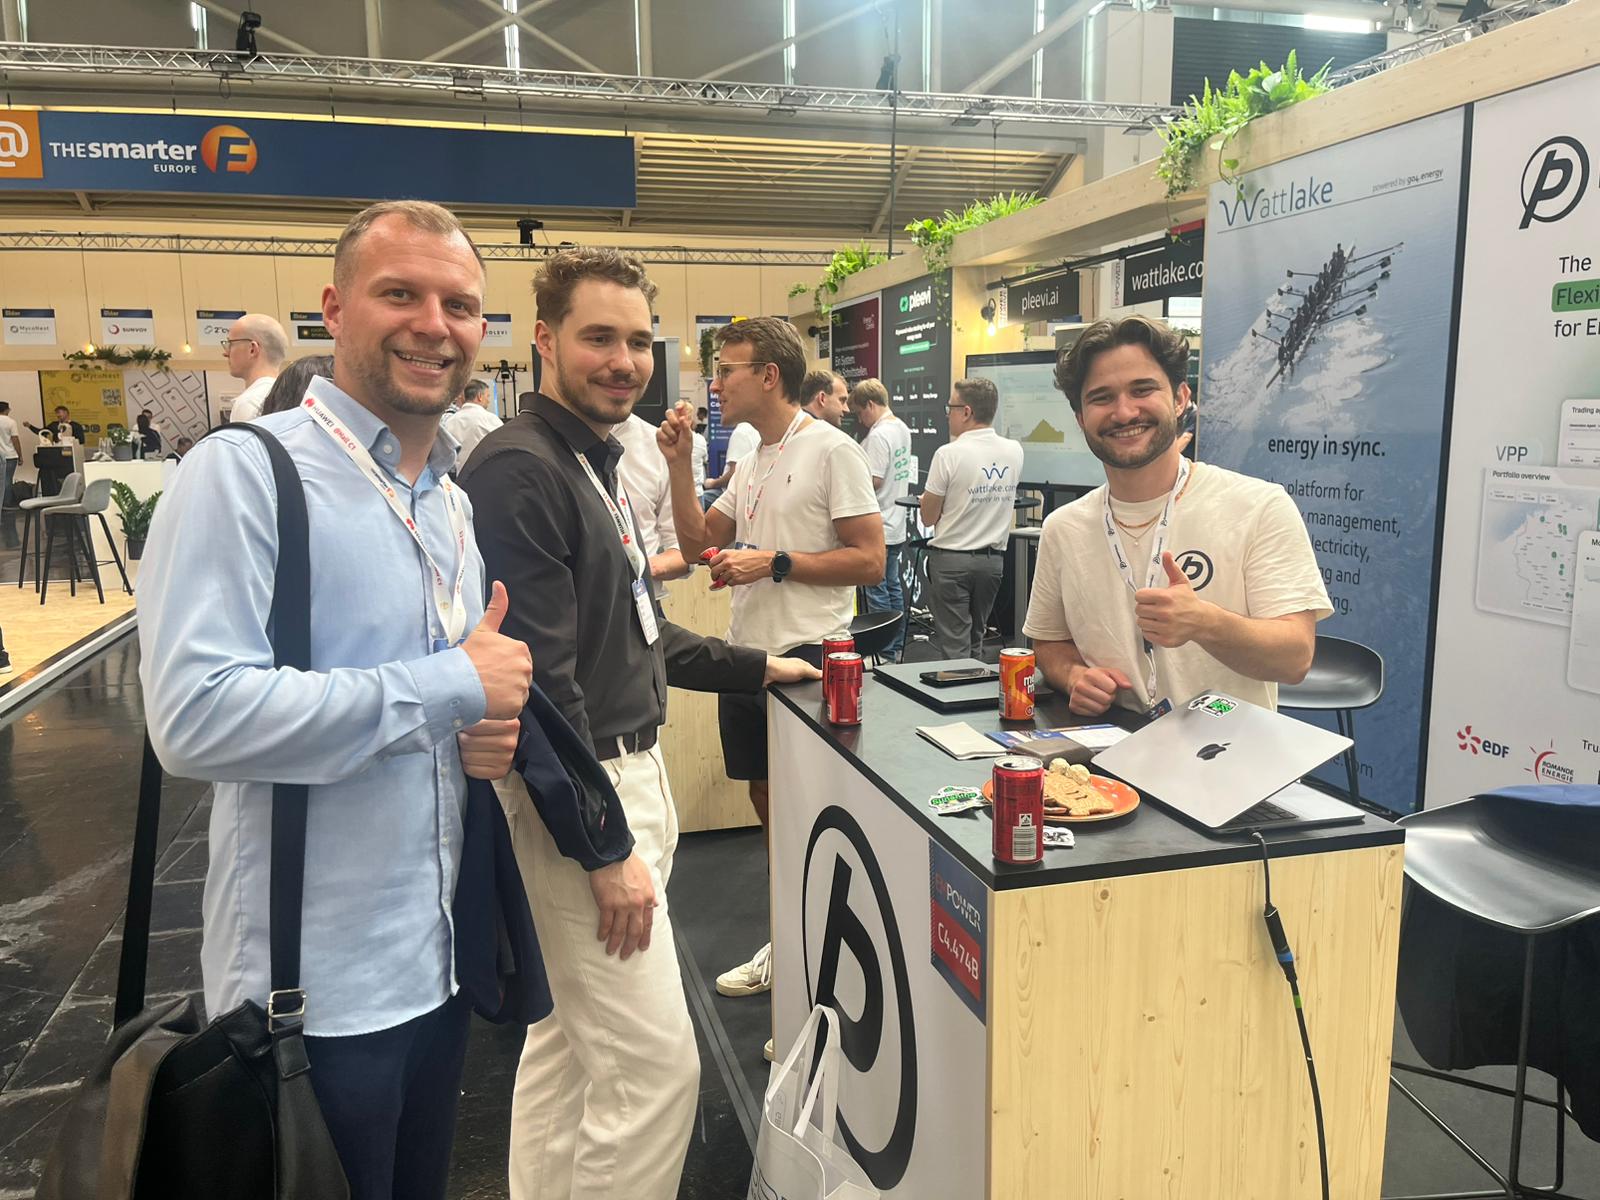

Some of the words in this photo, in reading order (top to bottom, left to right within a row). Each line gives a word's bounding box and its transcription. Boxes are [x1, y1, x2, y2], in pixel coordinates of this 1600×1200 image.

[153, 164, 197, 174] EUROPE
[1219, 176, 1333, 226] Wattlake
[1559, 255, 1592, 274] The
[909, 286, 932, 312] pleevi
[1021, 286, 1059, 315] pleevi.ai
[1556, 285, 1600, 306] Flexi
[1554, 319, 1582, 337] for
[1586, 318, 1600, 336] E
[312, 405, 335, 428] HUAWEI
[1571, 406, 1594, 415] Trading
[1268, 438, 1320, 461] energy
[1323, 434, 1337, 455] in
[1342, 440, 1386, 462] sync.
[1496, 445, 1528, 462] VPP
[1492, 470, 1520, 479] Portfolio
[1521, 473, 1550, 481] overview
[1287, 480, 1340, 500] platform
[1344, 482, 1365, 501] for
[1307, 511, 1401, 538] management,
[1335, 567, 1361, 585] and
[1582, 740, 1600, 753] Tru
[1541, 767, 1574, 782] ENERGIE
[1542, 760, 1574, 776] ROMANDE
[938, 922, 979, 980] C4.474B
